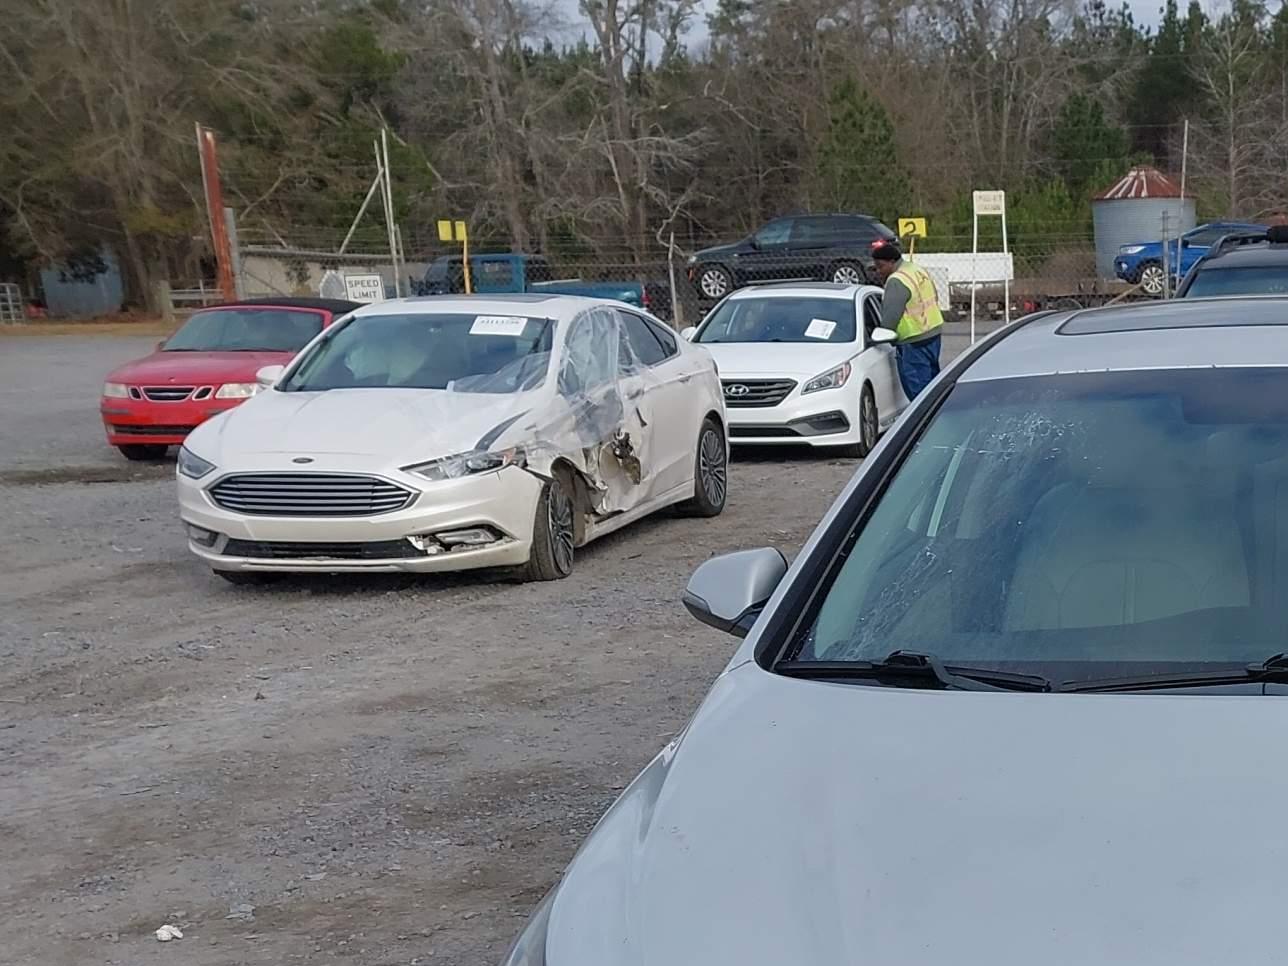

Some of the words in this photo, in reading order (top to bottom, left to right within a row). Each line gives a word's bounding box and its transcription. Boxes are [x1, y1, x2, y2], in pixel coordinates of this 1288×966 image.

[903, 221, 921, 238] 2
[347, 280, 379, 288] SPEED
[353, 290, 378, 299] LIMIT
